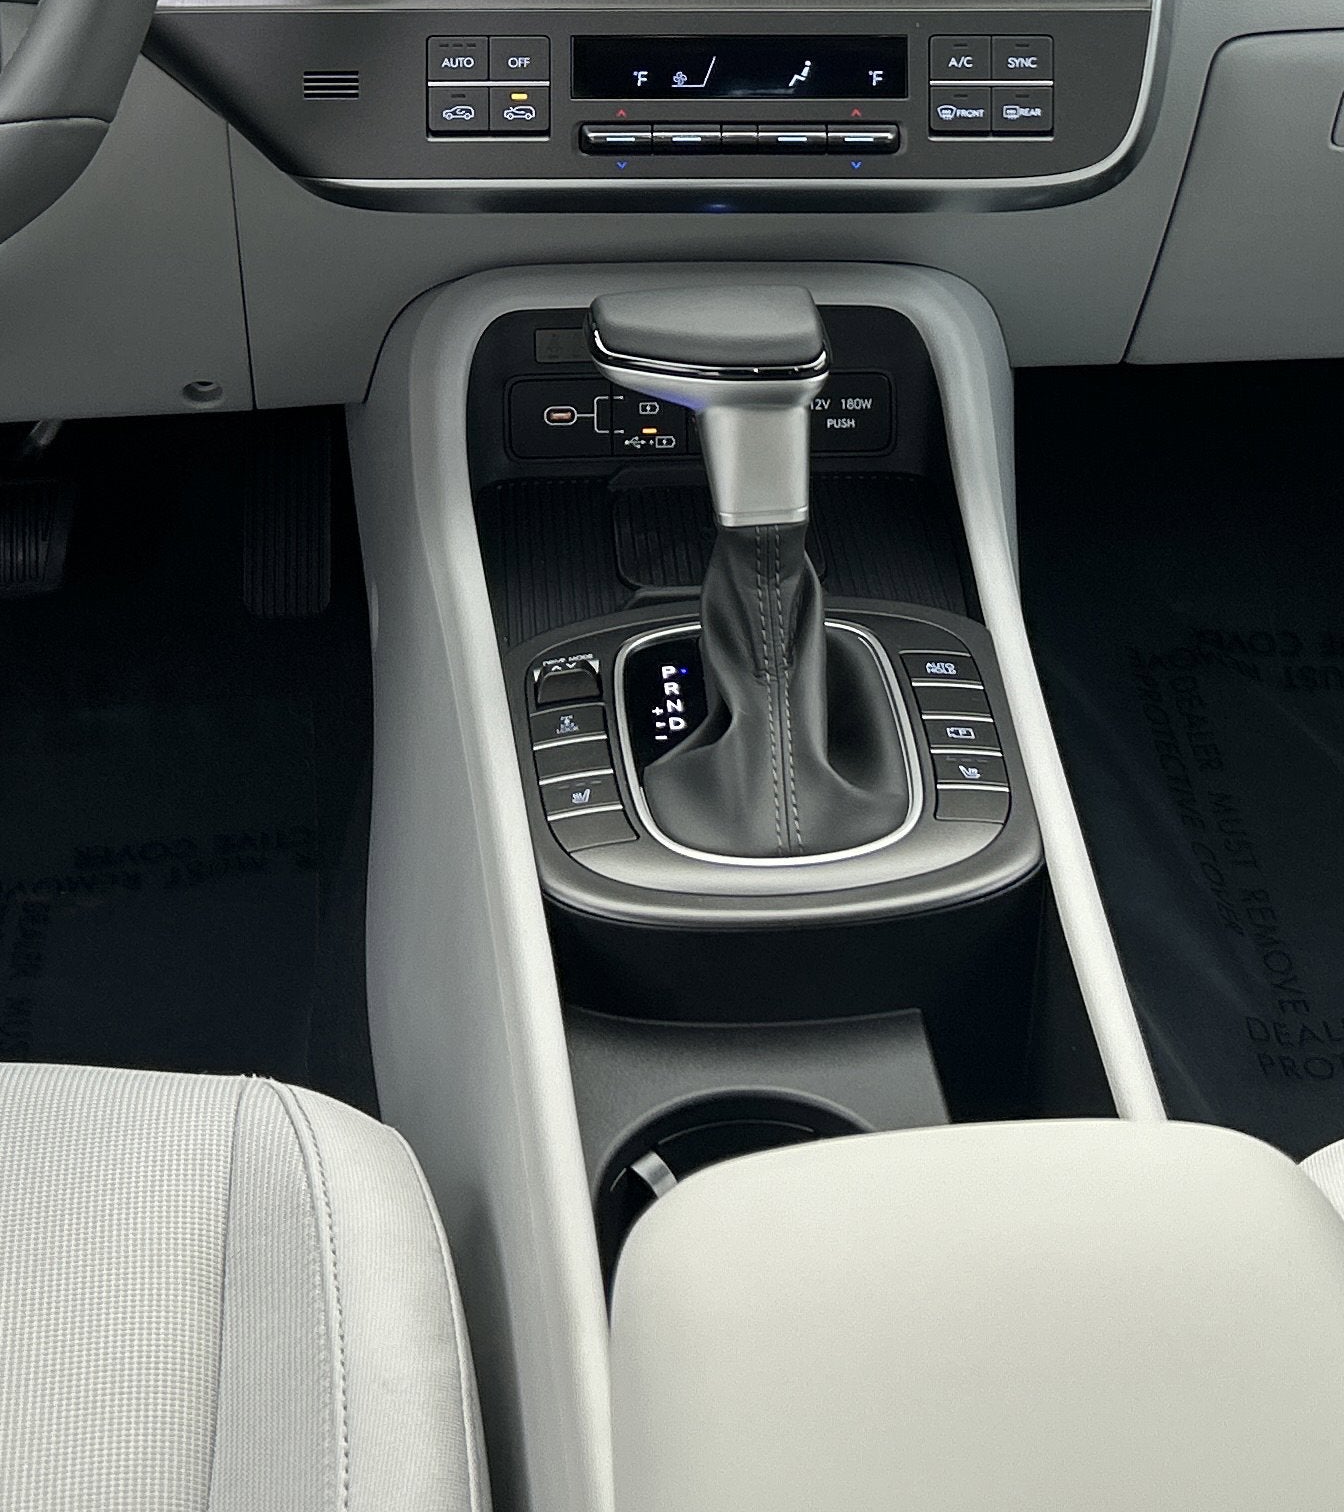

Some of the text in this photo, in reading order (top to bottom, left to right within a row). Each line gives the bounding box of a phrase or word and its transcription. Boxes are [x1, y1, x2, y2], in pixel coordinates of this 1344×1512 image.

[441, 56, 475, 68] AUTO
[507, 56, 531, 68] OFF
[948, 56, 974, 68] A/C
[1007, 56, 1038, 69] SYNC
[956, 108, 985, 118] FRONT
[1019, 108, 1042, 117] REAR
[840, 398, 872, 410] 180W
[826, 418, 856, 429] PUSH
[661, 665, 677, 679] P
[663, 682, 680, 696] R
[666, 699, 683, 713] N
[668, 716, 686, 730] D
